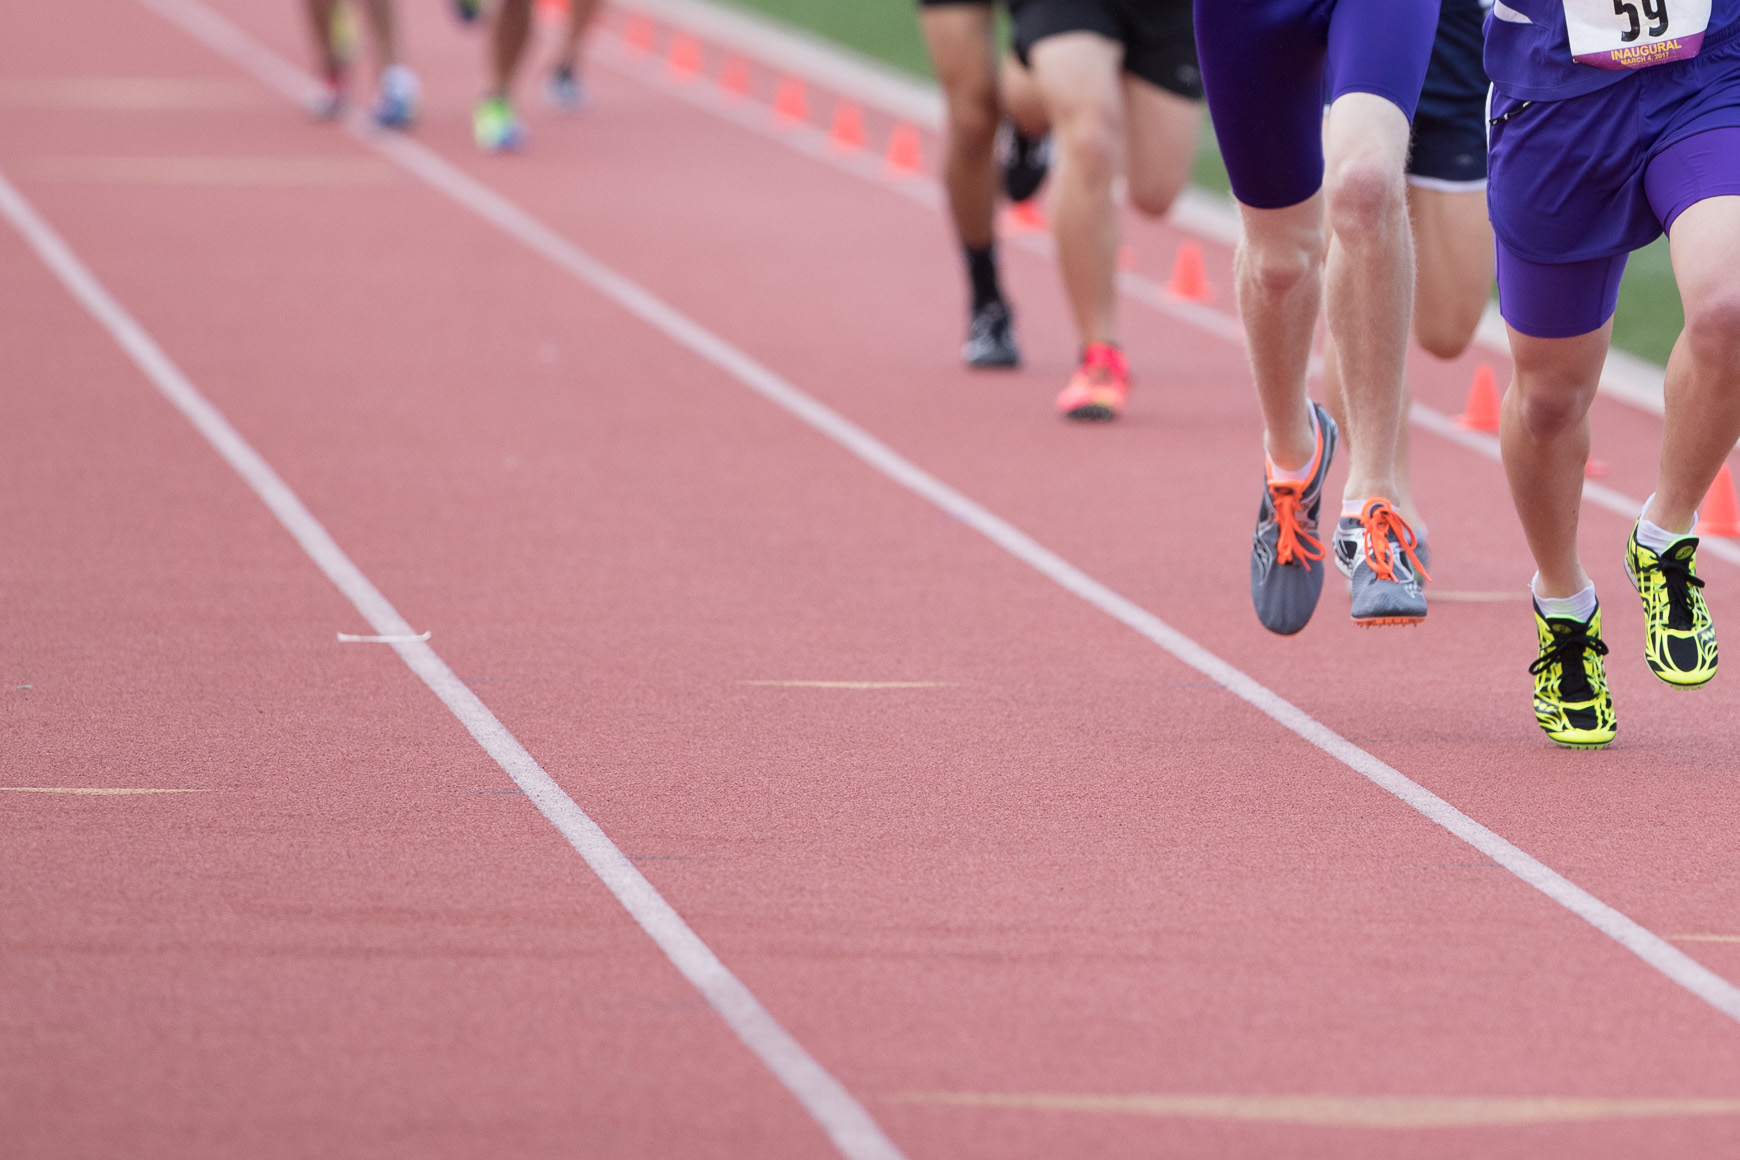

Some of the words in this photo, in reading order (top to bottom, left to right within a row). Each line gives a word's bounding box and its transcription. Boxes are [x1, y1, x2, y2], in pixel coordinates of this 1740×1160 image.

[1611, 40, 1683, 60] INAUGURAL
[1620, 56, 1647, 65] MARCH
[1654, 51, 1670, 60] 2017
